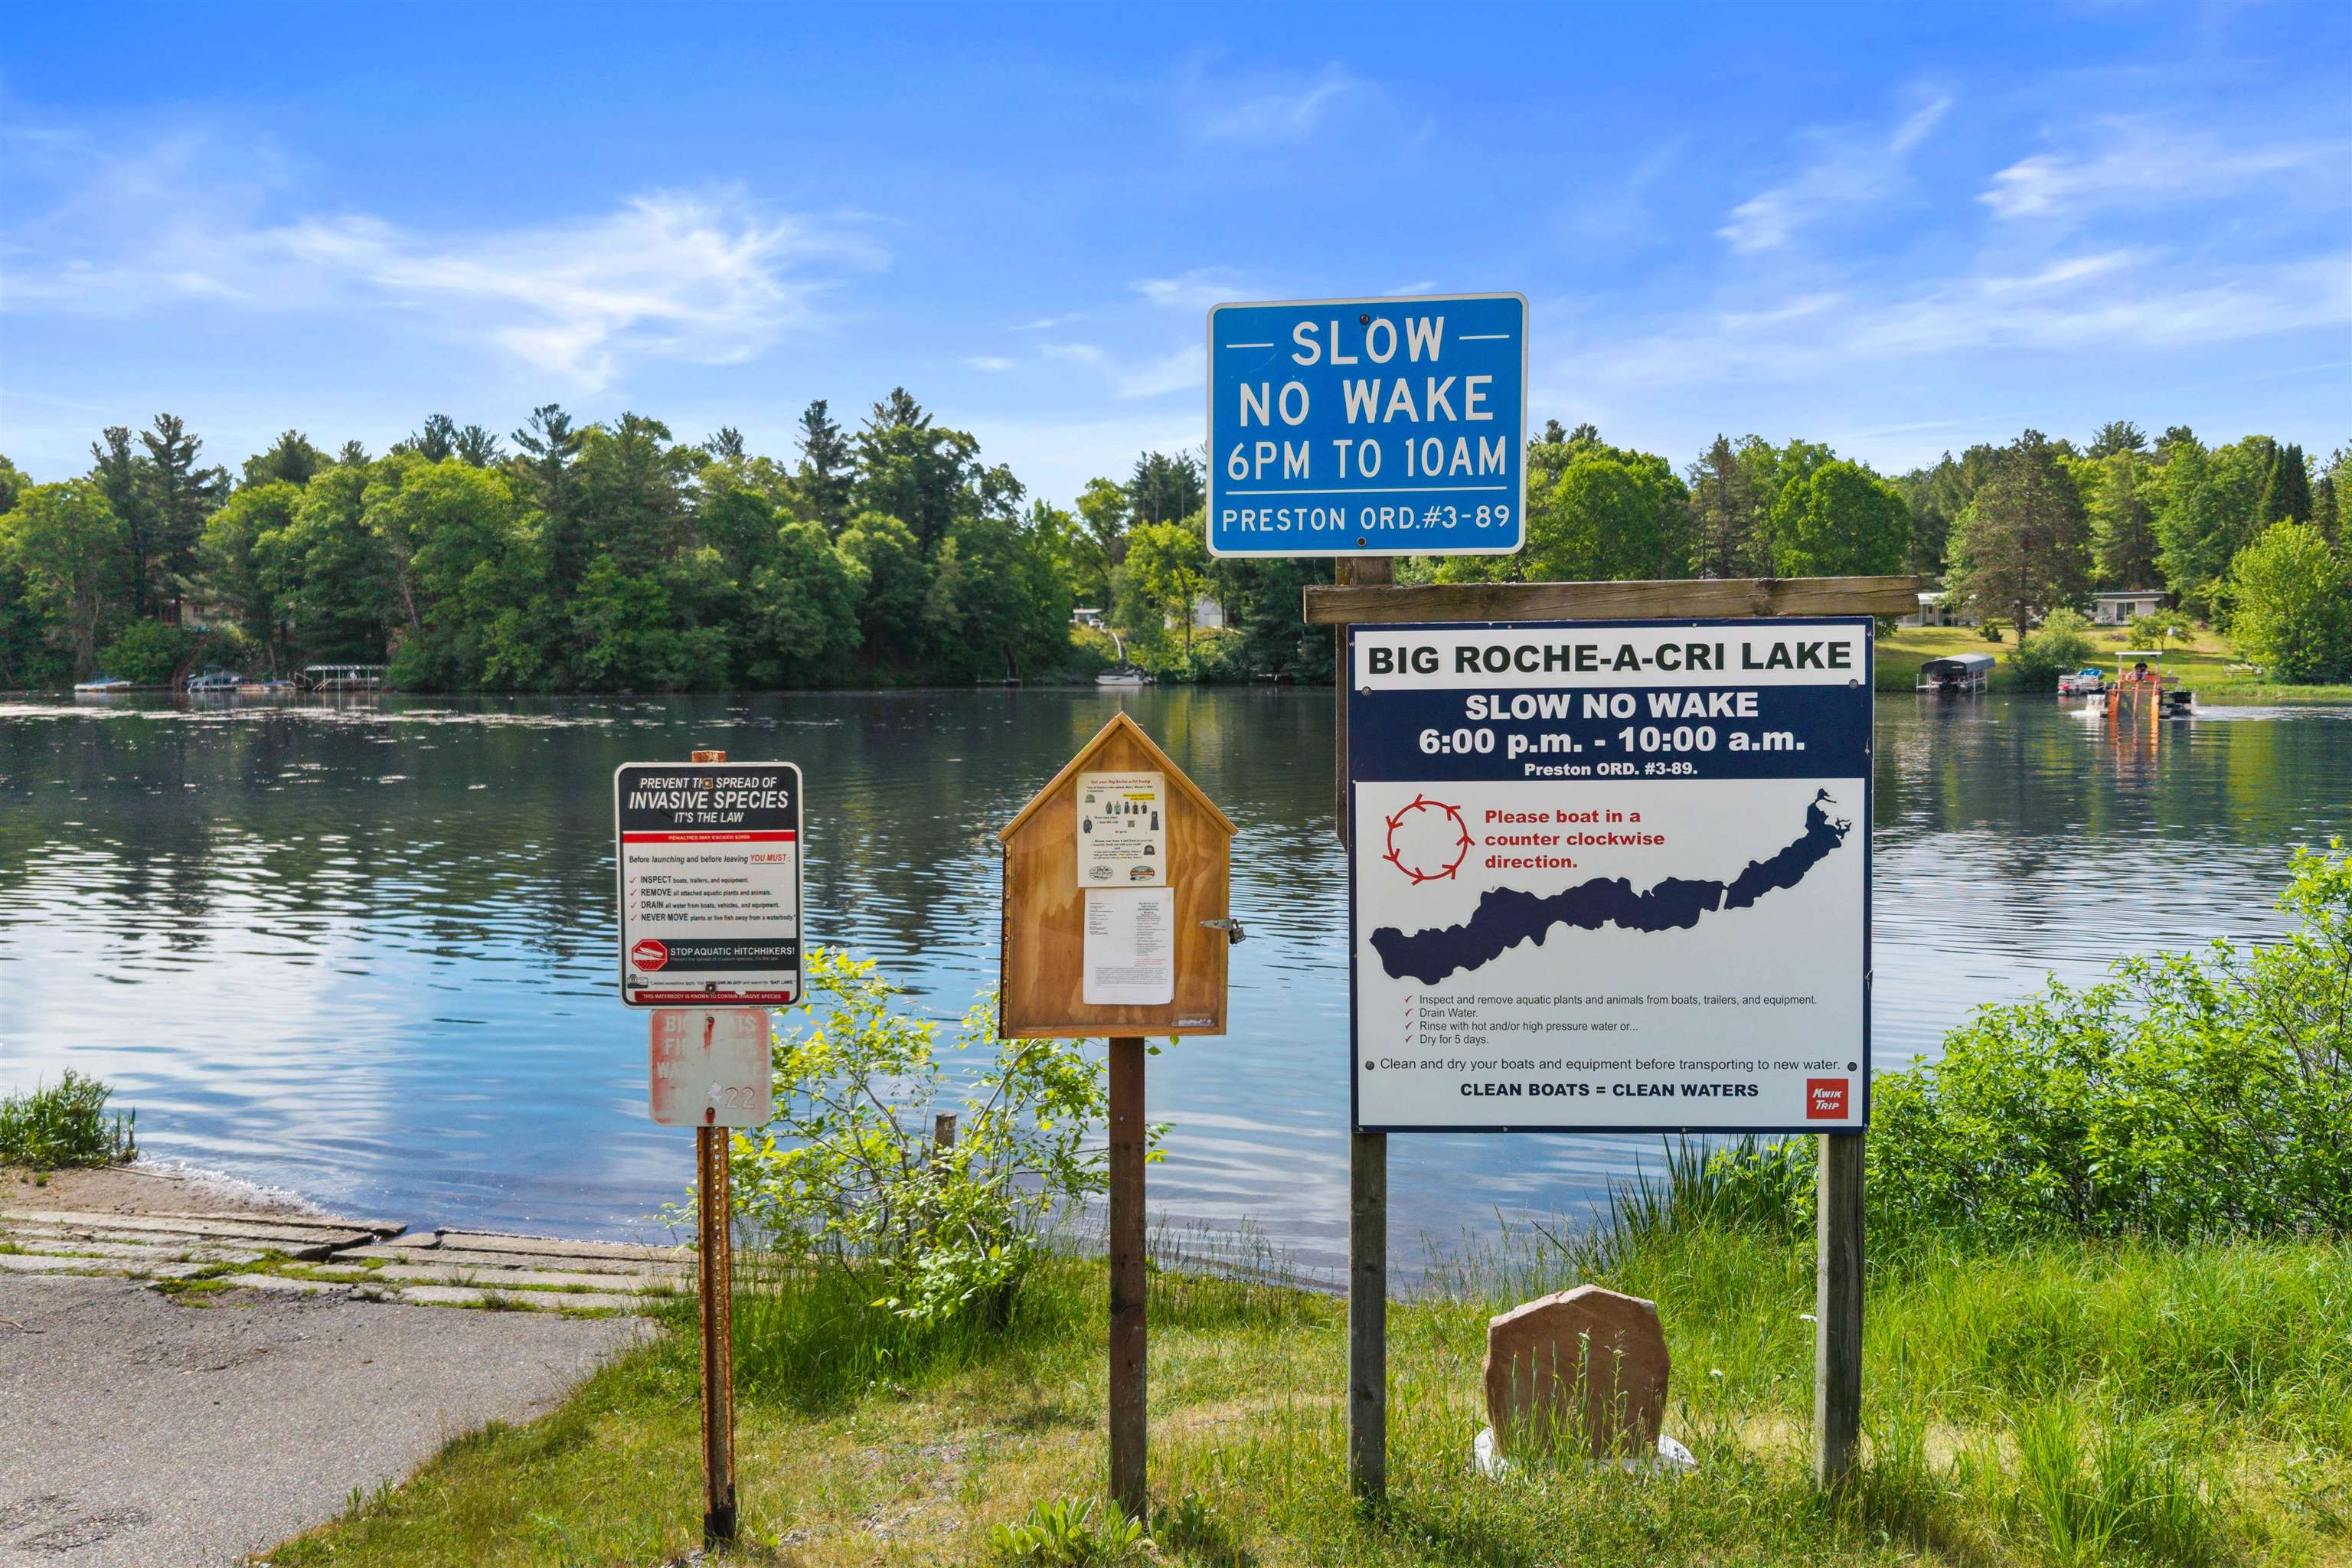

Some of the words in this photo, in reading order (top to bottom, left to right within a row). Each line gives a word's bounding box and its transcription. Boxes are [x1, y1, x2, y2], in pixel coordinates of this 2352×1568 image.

[1292, 316, 1444, 366] SLOW
[1240, 381, 1308, 427] NO
[1343, 375, 1494, 424] WAKE
[1227, 440, 1309, 482] 6PM
[1333, 438, 1381, 479] TO
[1406, 436, 1506, 477] 10AM
[1223, 508, 1345, 532] PRESTON
[1369, 646, 1439, 675] BIG
[1455, 642, 1724, 674] ROCHE-A-CRI
[1742, 641, 1851, 670] LAKE
[1465, 694, 1572, 720] SLOW
[1583, 693, 1637, 719] NO
[1647, 691, 1759, 718] WAKE
[1419, 727, 1495, 754] 6:00
[1508, 733, 1583, 760] p.m.
[1618, 725, 1717, 753] 10:00
[1728, 731, 1805, 752] a.m.
[1524, 763, 1592, 776] Preston
[1596, 762, 1640, 776] ORD.
[1644, 761, 1698, 776] #3-89.
[639, 777, 691, 789] PREVENT
[691, 777, 714, 790] TH
[715, 776, 760, 789] SPREAD
[762, 776, 778, 789] OF
[629, 791, 709, 809] INVASIVE
[713, 790, 789, 809] SPECIES
[674, 812, 694, 823] IT'S
[697, 812, 718, 823] THE
[720, 812, 744, 823] LAW
[1485, 809, 1550, 824] Please
[1556, 809, 1599, 824] boat
[1606, 808, 1623, 823] in
[1628, 812, 1642, 823] a
[1484, 832, 1561, 846] counter
[1566, 831, 1665, 846] clockwise
[629, 855, 649, 864] Before
[652, 855, 684, 865] launching
[687, 855, 698, 864] and
[701, 854, 722, 863] before
[724, 855, 748, 864] leaving
[751, 854, 764, 862] YOU
[1485, 854, 1578, 869] direction.
[641, 875, 671, 884] INSPECT
[641, 887, 671, 897] REMOVE
[642, 900, 664, 909] DRAIN
[642, 913, 665, 922] NEVER
[668, 913, 688, 922] MOVE
[670, 947, 694, 956] STOP
[694, 947, 732, 956] AQUATIC
[733, 946, 795, 956] HITCHHIKERS!
[1419, 995, 1455, 1007] Inspect
[1456, 995, 1475, 1004] and
[1477, 996, 1514, 1004] remove
[1515, 994, 1551, 1007] aquatic
[1553, 995, 1583, 1007] plants
[1585, 995, 1604, 1004] and
[1606, 995, 1645, 1005] animals
[1646, 994, 1668, 1005] from
[1671, 995, 1701, 1005] boats,
[1704, 995, 1740, 1006] trailers,
[1742, 995, 1761, 1005] and
[1762, 995, 1817, 1007] equipment.
[1419, 1008, 1446, 1018] Drain
[1448, 1008, 1478, 1018] Water.
[1419, 1021, 1447, 1031] Rinse
[1449, 1021, 1469, 1031] with
[1472, 1021, 1488, 1031] hot
[1489, 1021, 1521, 1031] and/or
[1522, 1021, 1544, 1034] high
[1546, 1023, 1589, 1033] pressure
[1590, 1021, 1618, 1031] water
[1619, 1023, 1638, 1031] or...
[1419, 1034, 1437, 1047] Dry
[1439, 1034, 1452, 1044] for
[1454, 1034, 1462, 1044] 5
[1463, 1034, 1489, 1047] days.
[1380, 1057, 1416, 1070] Clean
[1419, 1058, 1443, 1070] and
[1447, 1058, 1467, 1072] dry
[1470, 1060, 1498, 1072] your
[1501, 1058, 1535, 1070] boats
[1538, 1058, 1562, 1070] and
[1566, 1058, 1632, 1072] equipment
[1635, 1058, 1676, 1070] before
[1679, 1059, 1754, 1073] transporting
[1757, 1059, 1770, 1070] to
[1773, 1060, 1799, 1070] new
[1802, 1059, 1841, 1070] water.
[724, 1086, 755, 1109] 22
[1460, 1083, 1522, 1096] CLEAN
[1528, 1083, 1590, 1096] BOATS
[1612, 1083, 1675, 1097] CLEAN
[1680, 1083, 1759, 1097] WATERS
